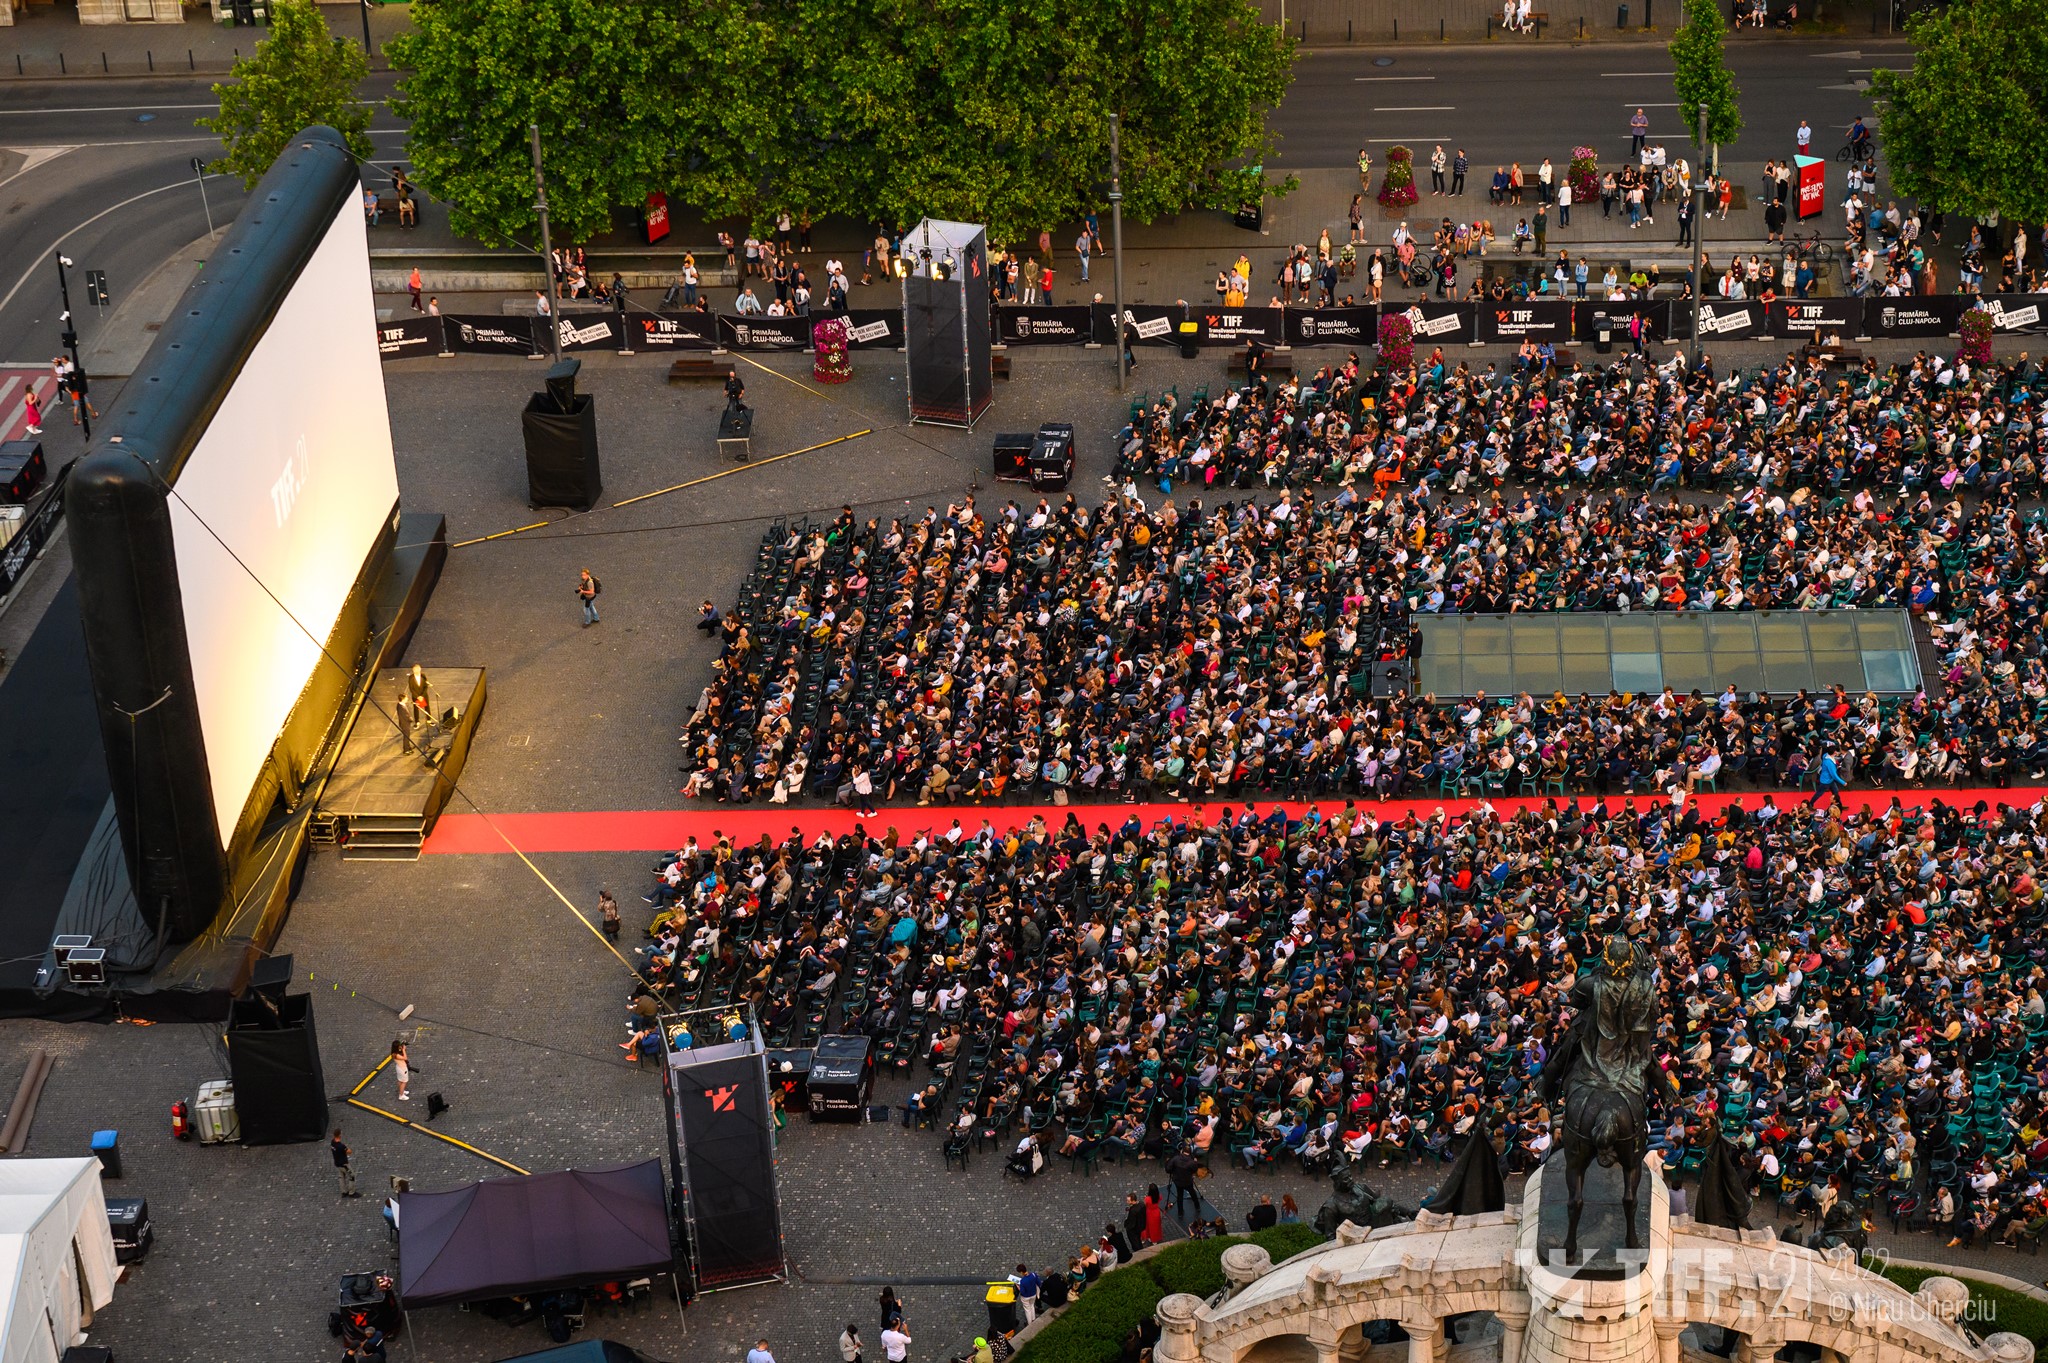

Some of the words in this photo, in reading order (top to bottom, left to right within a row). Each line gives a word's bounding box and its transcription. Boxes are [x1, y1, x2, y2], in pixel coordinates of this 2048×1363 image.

[1512, 310, 1532, 322] TIFF
[1803, 306, 1823, 318] TIFF
[1898, 310, 1929, 318] PRIMĂRIA
[658, 320, 678, 332] TIFF
[1222, 316, 1242, 326] TIFF
[1318, 320, 1348, 328] PRIMĂRIA
[384, 328, 404, 340] TIFF
[752, 328, 782, 336] PRIMĂRIA
